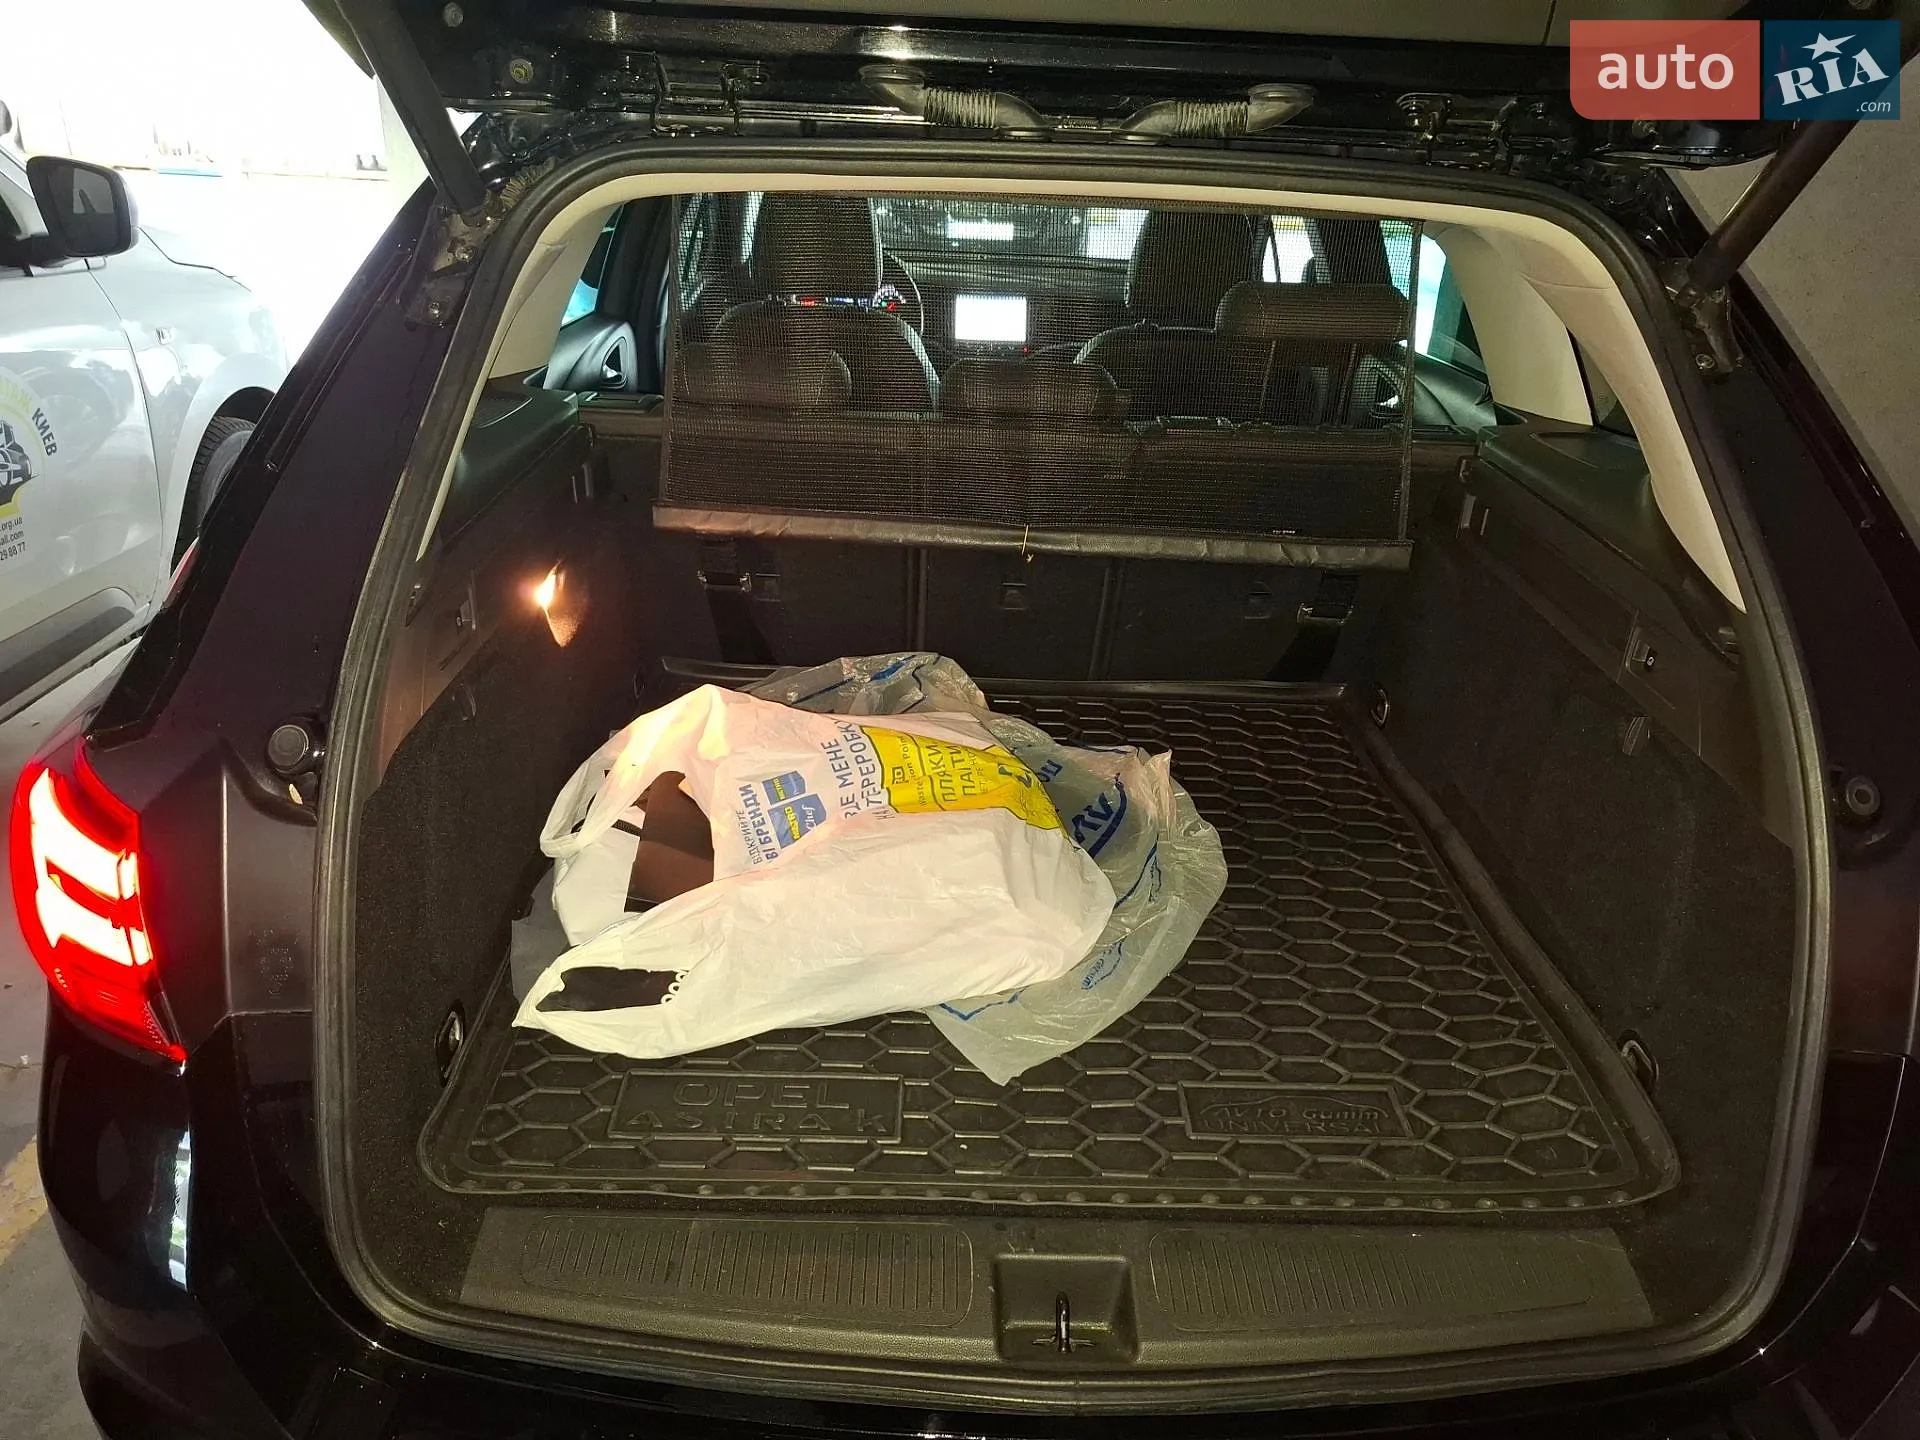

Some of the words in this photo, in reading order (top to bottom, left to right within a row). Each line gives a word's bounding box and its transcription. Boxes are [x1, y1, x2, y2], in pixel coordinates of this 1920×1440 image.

[31, 407, 58, 457] КИЕВ
[821, 739, 854, 789] МЕНЕ
[739, 783, 773, 845] БРЕНДИ
[628, 1111, 832, 1131] ASTRA
[673, 1083, 849, 1109] OPEL
